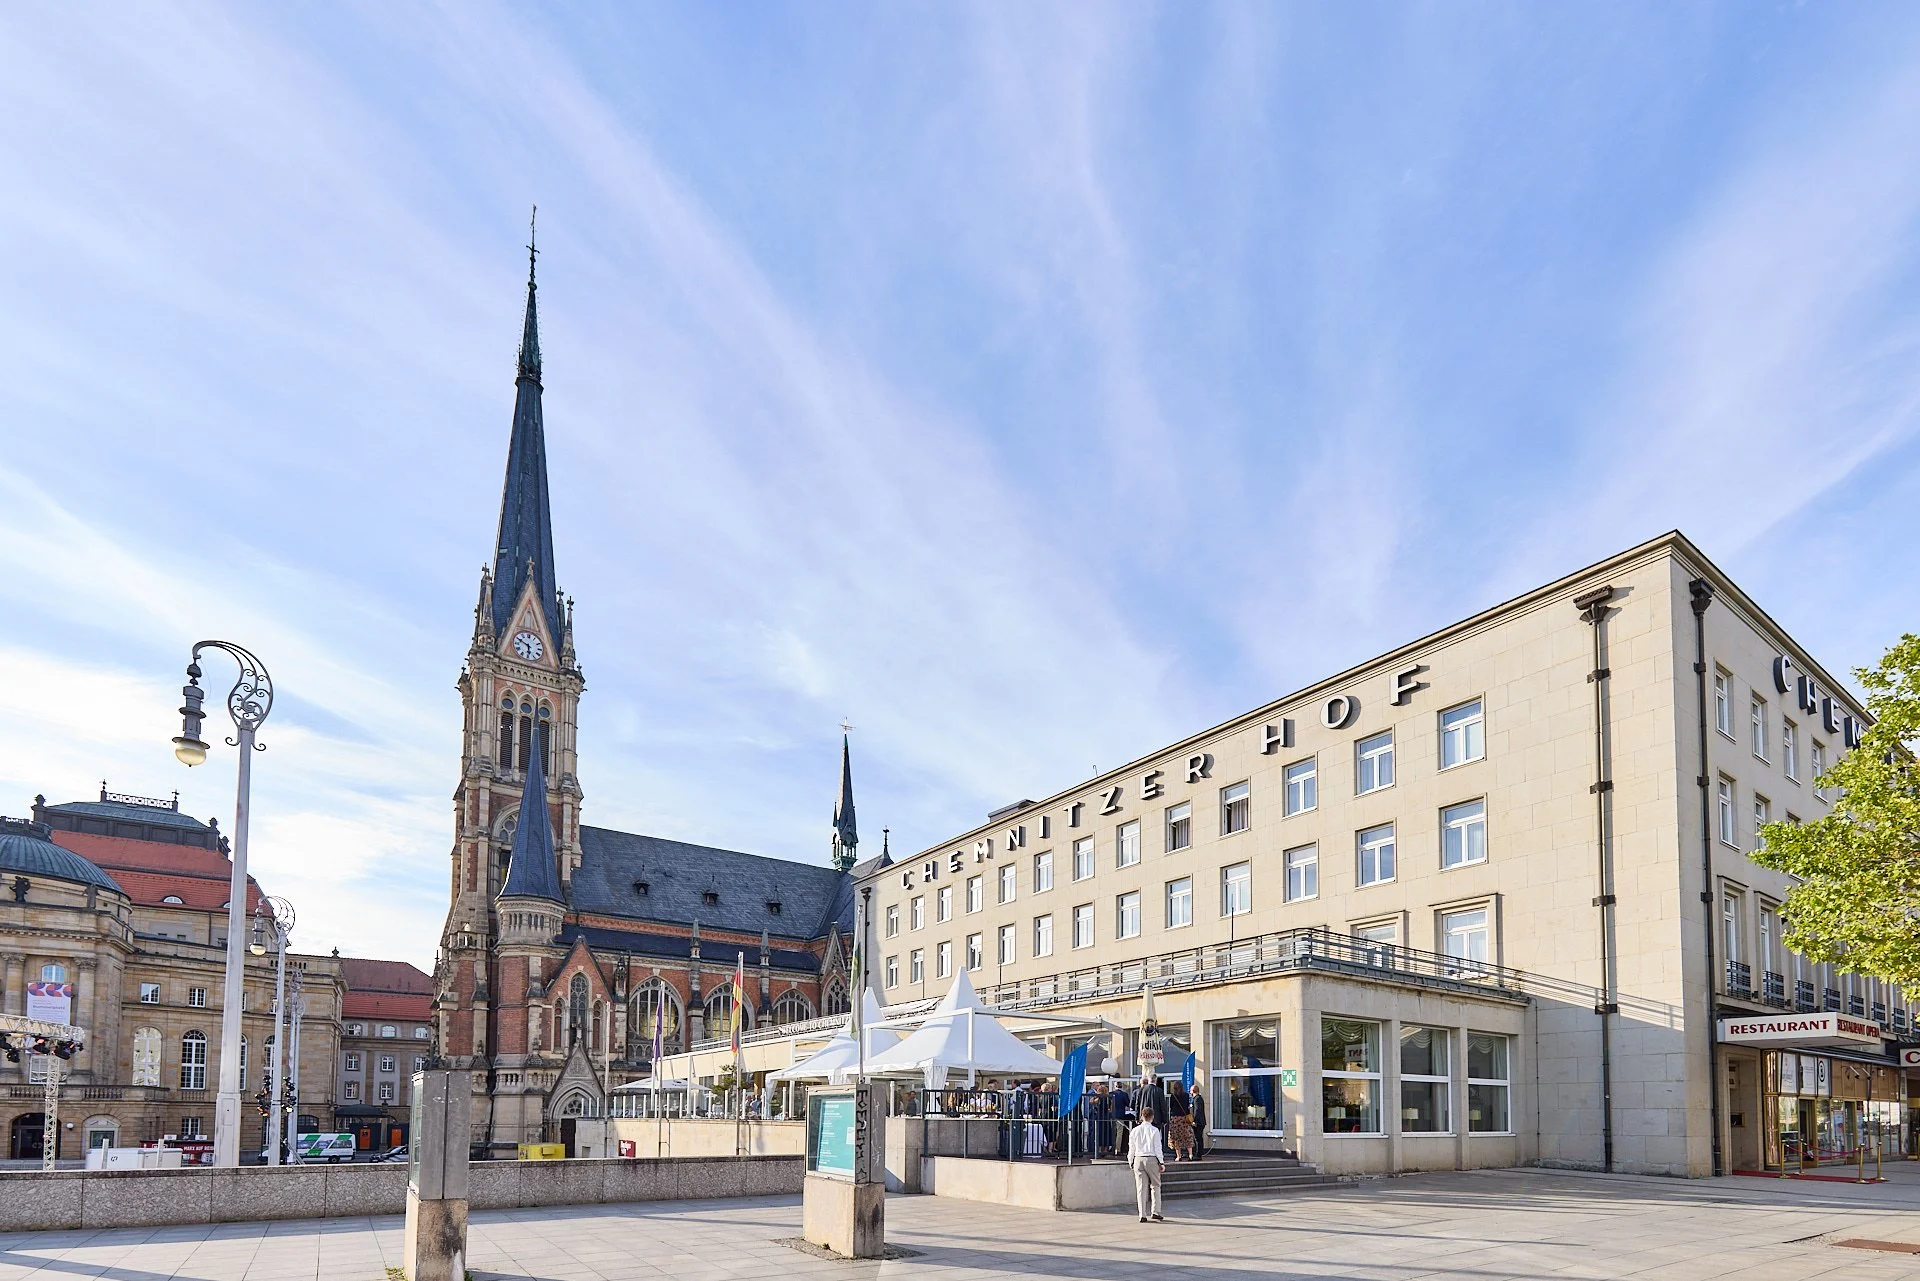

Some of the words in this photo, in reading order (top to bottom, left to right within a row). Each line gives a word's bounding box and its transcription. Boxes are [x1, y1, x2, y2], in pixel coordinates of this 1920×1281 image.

[899, 752, 1207, 891] CHEMNITZER
[1259, 664, 1423, 755] HOF
[779, 1021, 808, 1036] WELCOME
[809, 1020, 817, 1031] TO
[1730, 1019, 1830, 1035] RESTAURANT
[1837, 1018, 1866, 1035] RESTAURANT
